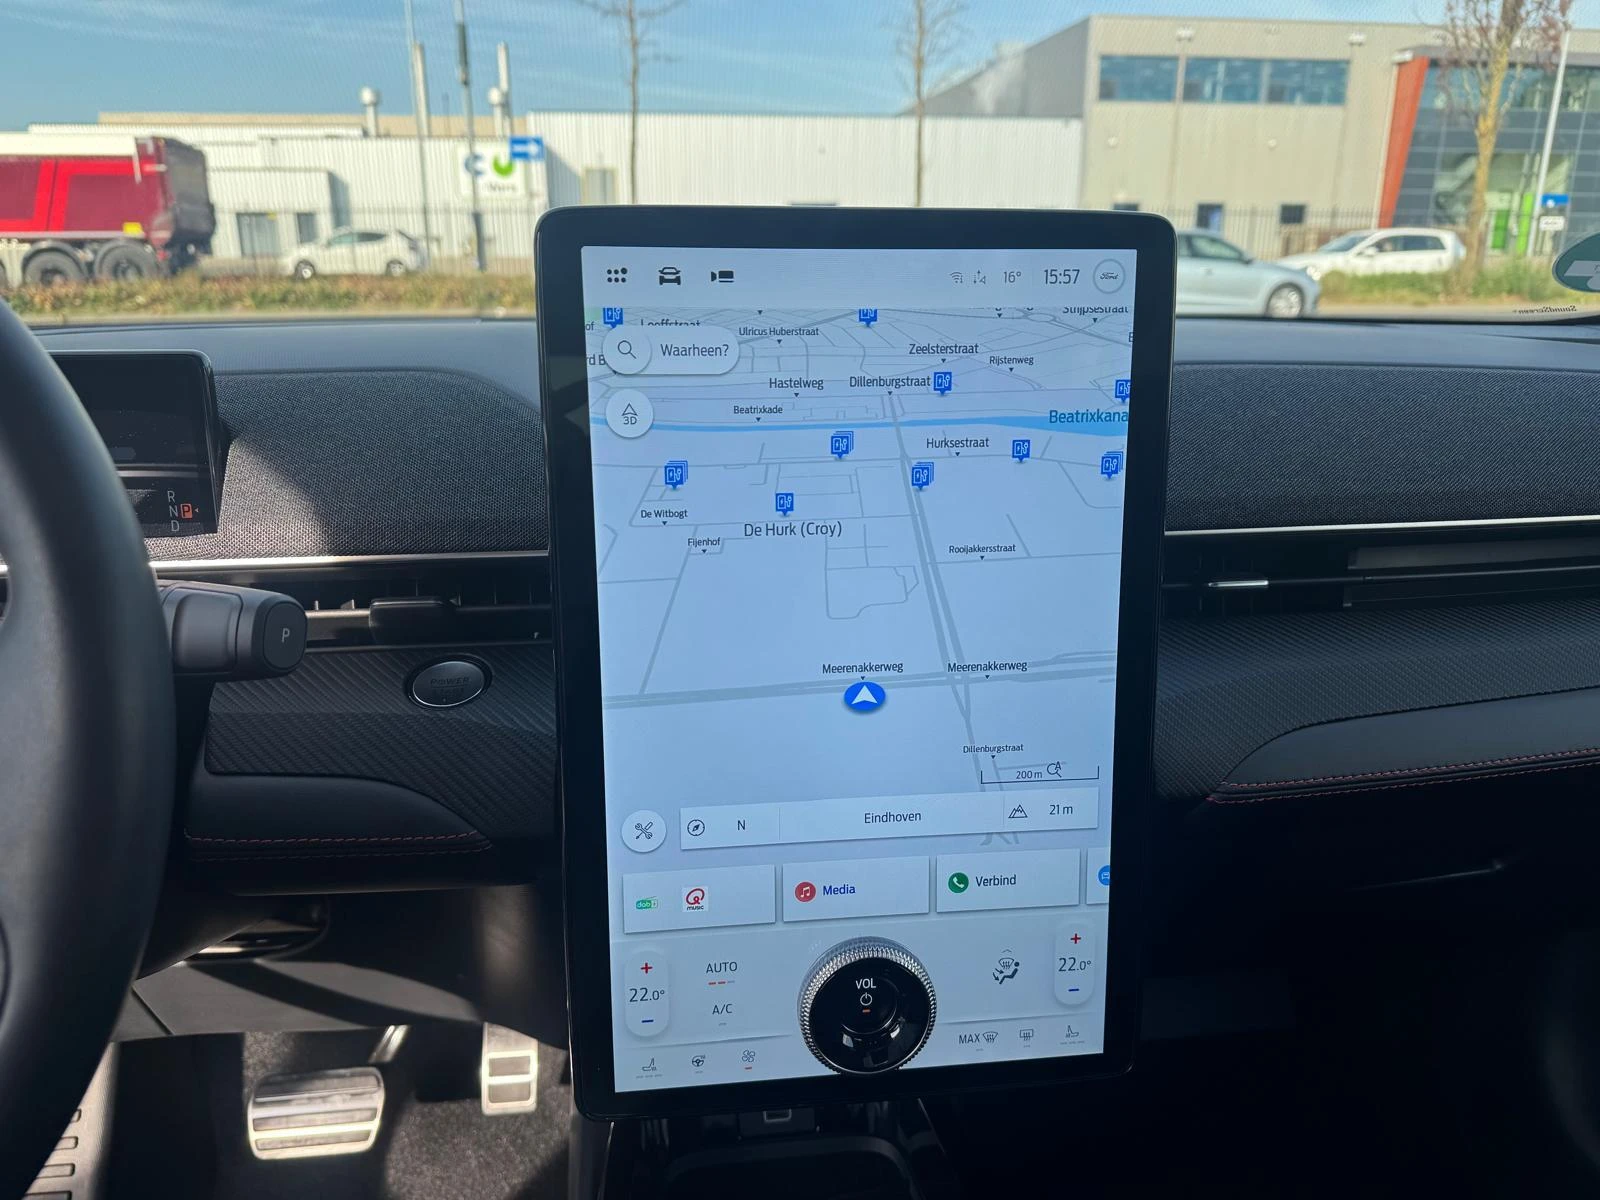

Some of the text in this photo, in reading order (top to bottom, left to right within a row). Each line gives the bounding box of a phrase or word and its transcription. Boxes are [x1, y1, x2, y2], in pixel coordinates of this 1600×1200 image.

[1003, 271, 1022, 283] 16°
[1043, 269, 1080, 285] 15:57
[738, 327, 819, 336] Ulricus Huberstraat
[660, 343, 729, 358] Waarheen?
[909, 343, 979, 355] Zeelsterstraat
[989, 356, 1034, 366] Rijstenweg
[769, 377, 824, 390] Hastelweg
[849, 376, 931, 389] Dillenburgstraat
[733, 405, 783, 415] Beatrixkade
[1049, 409, 1129, 423] Beatrixkana
[623, 416, 637, 425] 3D
[926, 437, 989, 449] Hurksestraat
[167, 490, 176, 502] R
[169, 505, 190, 516] N P
[641, 509, 688, 519] De Witbogt
[171, 520, 180, 532] D
[744, 521, 842, 538] De Hurk (Croy)
[687, 537, 721, 548] Fijenhof
[948, 543, 1016, 554] Rooijakkersstraat
[281, 628, 290, 643] P
[822, 662, 904, 675] Meerenakkerweg
[947, 661, 1028, 673] Meerenakkerweg
[963, 743, 1024, 755] Dillenburgstraat
[1016, 770, 1043, 780] 200 m
[1049, 804, 1073, 816] 21 m
[864, 811, 922, 824] Eindhoven
[737, 819, 746, 831] N
[975, 873, 1017, 887] Verbind
[822, 884, 856, 896] Media
[706, 961, 738, 974] AUTO
[855, 978, 877, 990] VOL
[712, 1003, 733, 1016] A/C
[958, 1033, 980, 1045] MAX
